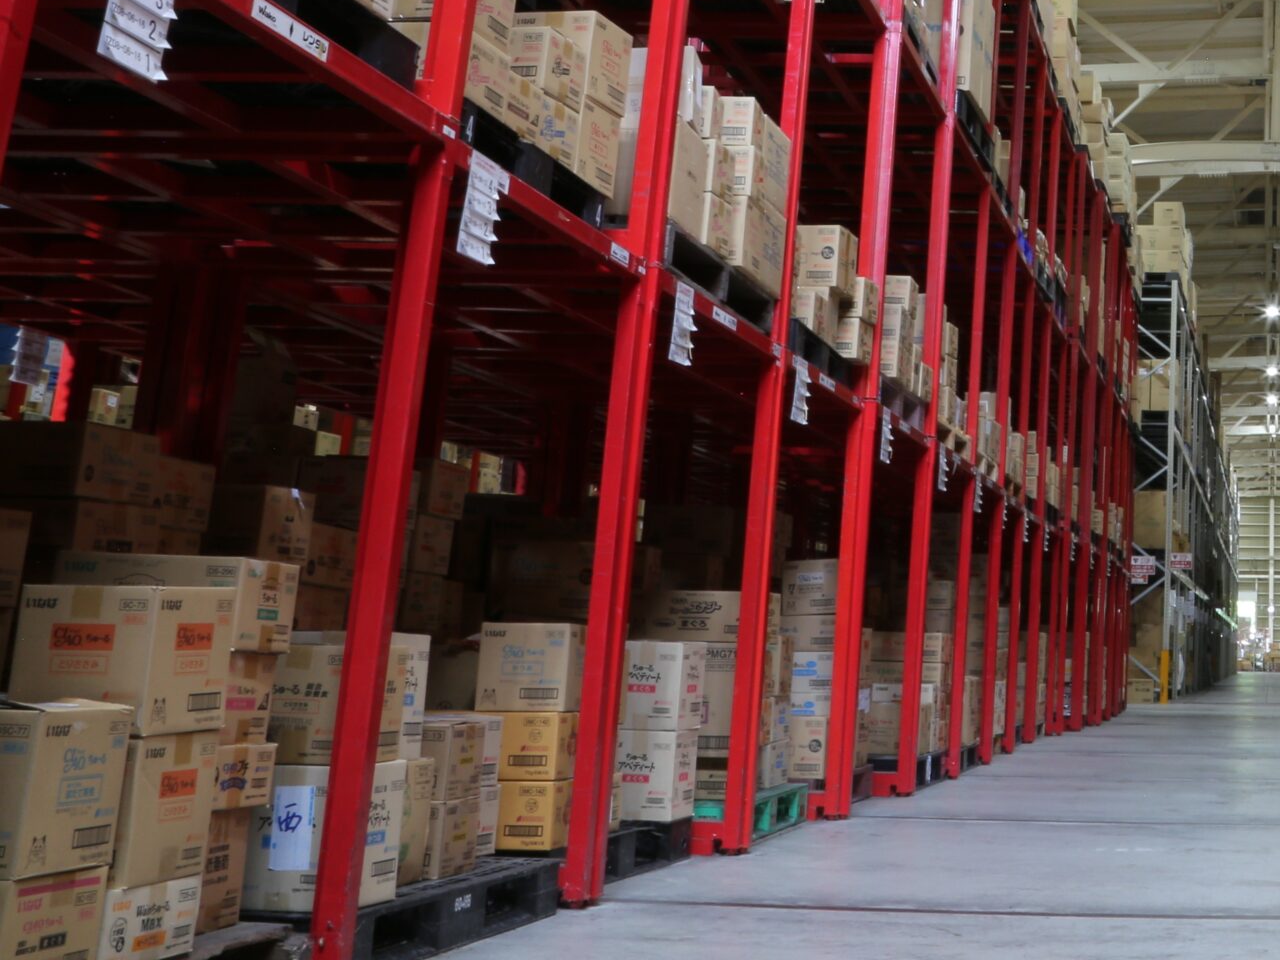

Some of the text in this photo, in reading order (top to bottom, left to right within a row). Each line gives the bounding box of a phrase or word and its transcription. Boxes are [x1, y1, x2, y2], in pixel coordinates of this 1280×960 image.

[148, 20, 157, 41] 2
[466, 115, 474, 144] 4
[25, 597, 60, 610] いなば
[46, 724, 73, 738] いなば
